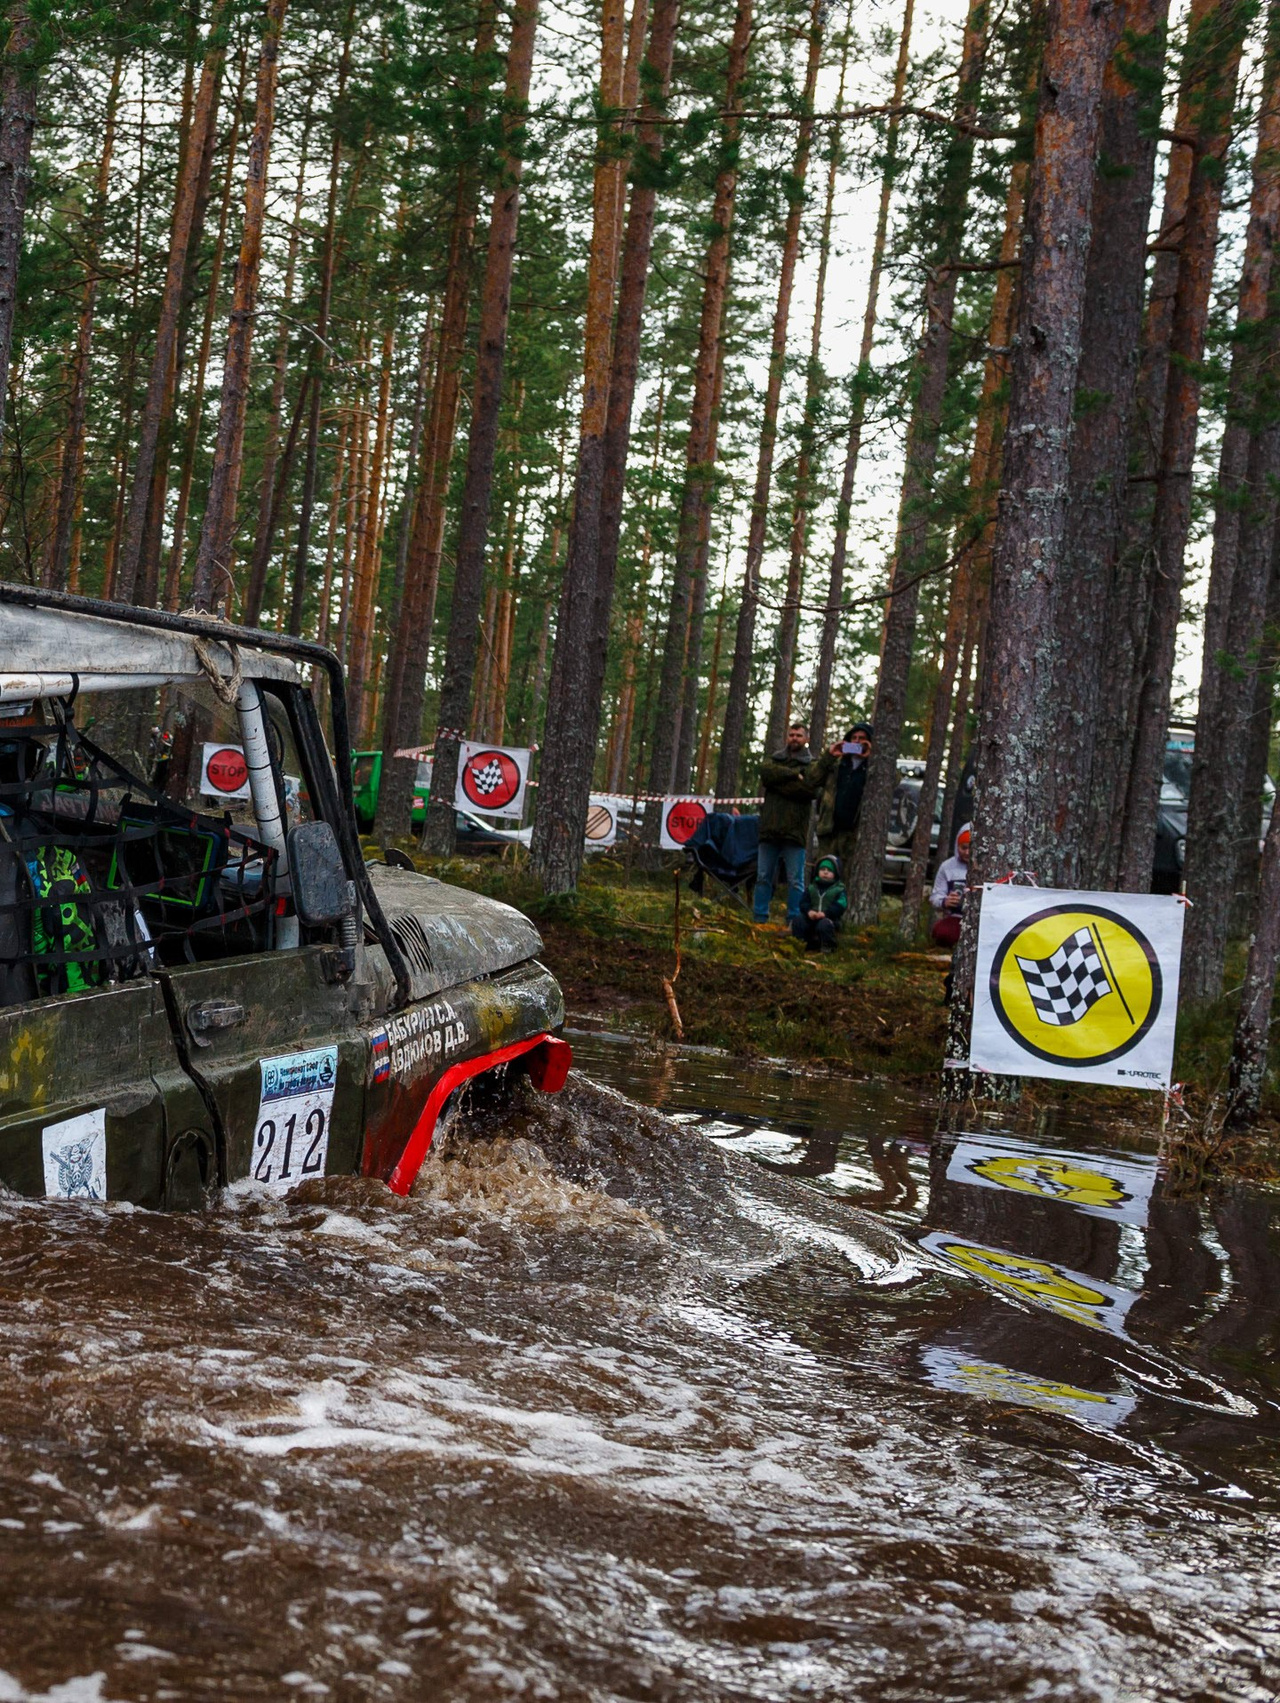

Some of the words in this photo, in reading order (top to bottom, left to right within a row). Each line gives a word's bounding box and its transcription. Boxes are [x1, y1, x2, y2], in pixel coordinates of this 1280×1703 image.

[211, 764, 245, 777] STOP
[385, 1006, 435, 1046] БАБУРИН
[445, 1021, 469, 1054] Д.В.
[255, 1108, 326, 1184] 212
